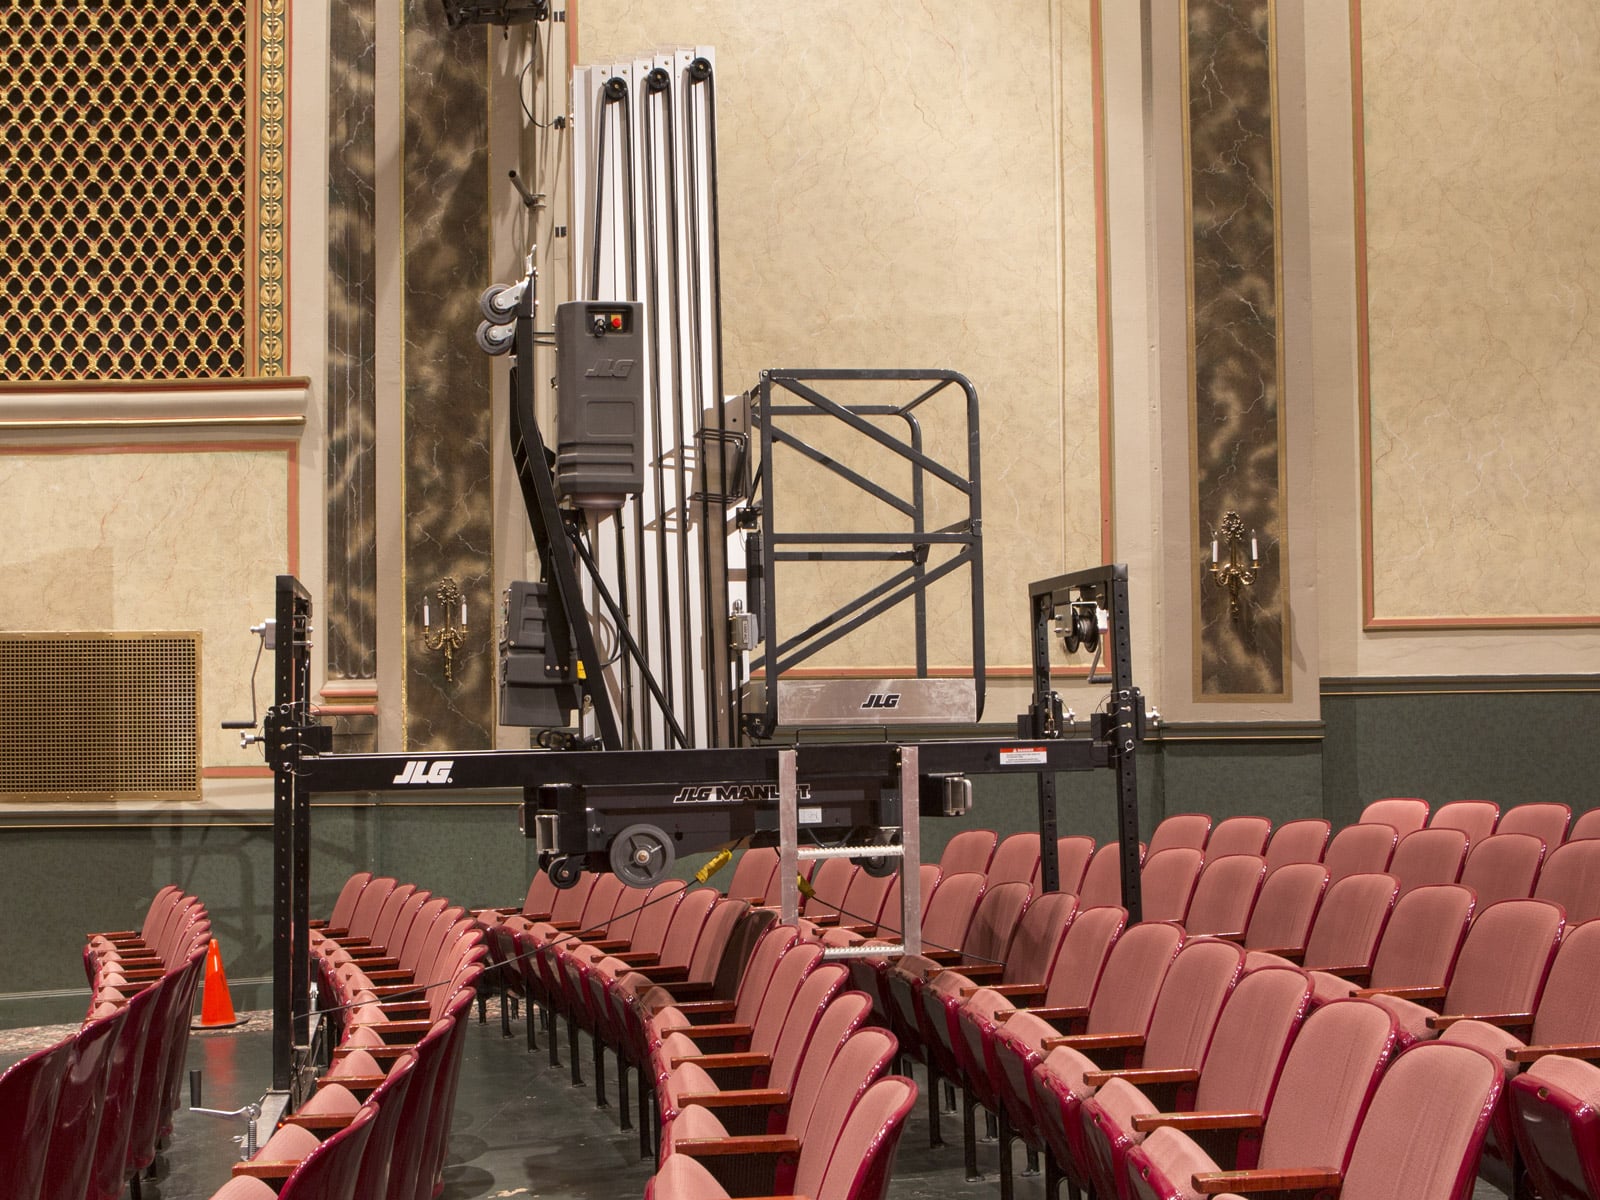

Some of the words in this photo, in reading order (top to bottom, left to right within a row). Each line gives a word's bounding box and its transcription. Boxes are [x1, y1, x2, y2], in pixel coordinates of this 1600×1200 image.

[584, 359, 634, 378] JLG
[861, 693, 901, 709] JLG
[673, 786, 715, 803] JLG
[714, 783, 811, 801] MANLT
